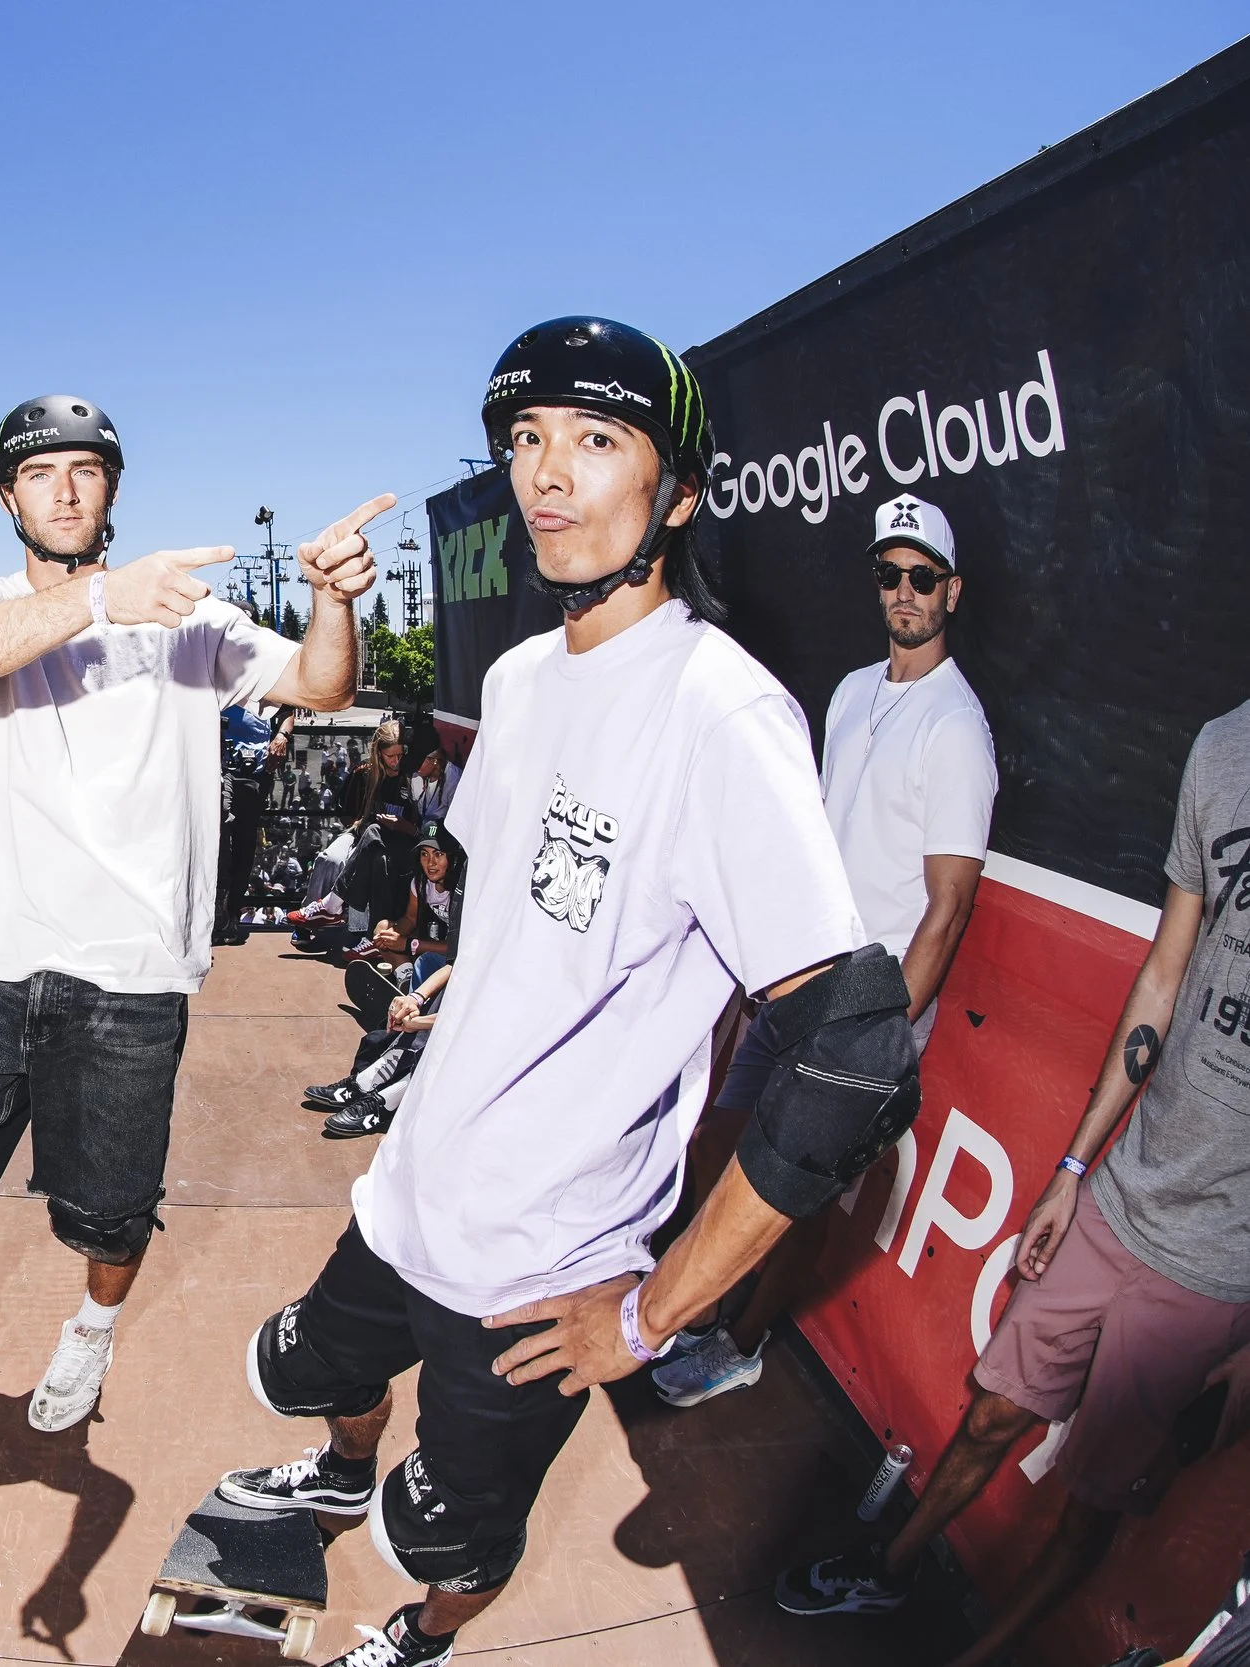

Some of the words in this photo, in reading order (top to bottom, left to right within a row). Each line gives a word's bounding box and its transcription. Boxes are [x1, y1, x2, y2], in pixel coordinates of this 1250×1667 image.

[574, 381, 606, 392] PRO
[623, 390, 652, 408] TEC
[3, 427, 60, 450] MONSTER
[708, 420, 869, 524] Google
[878, 349, 1066, 485] Cloud
[890, 521, 920, 531] GAMES
[406, 1479, 421, 1505] PADS
[866, 1464, 891, 1504] CHASER
